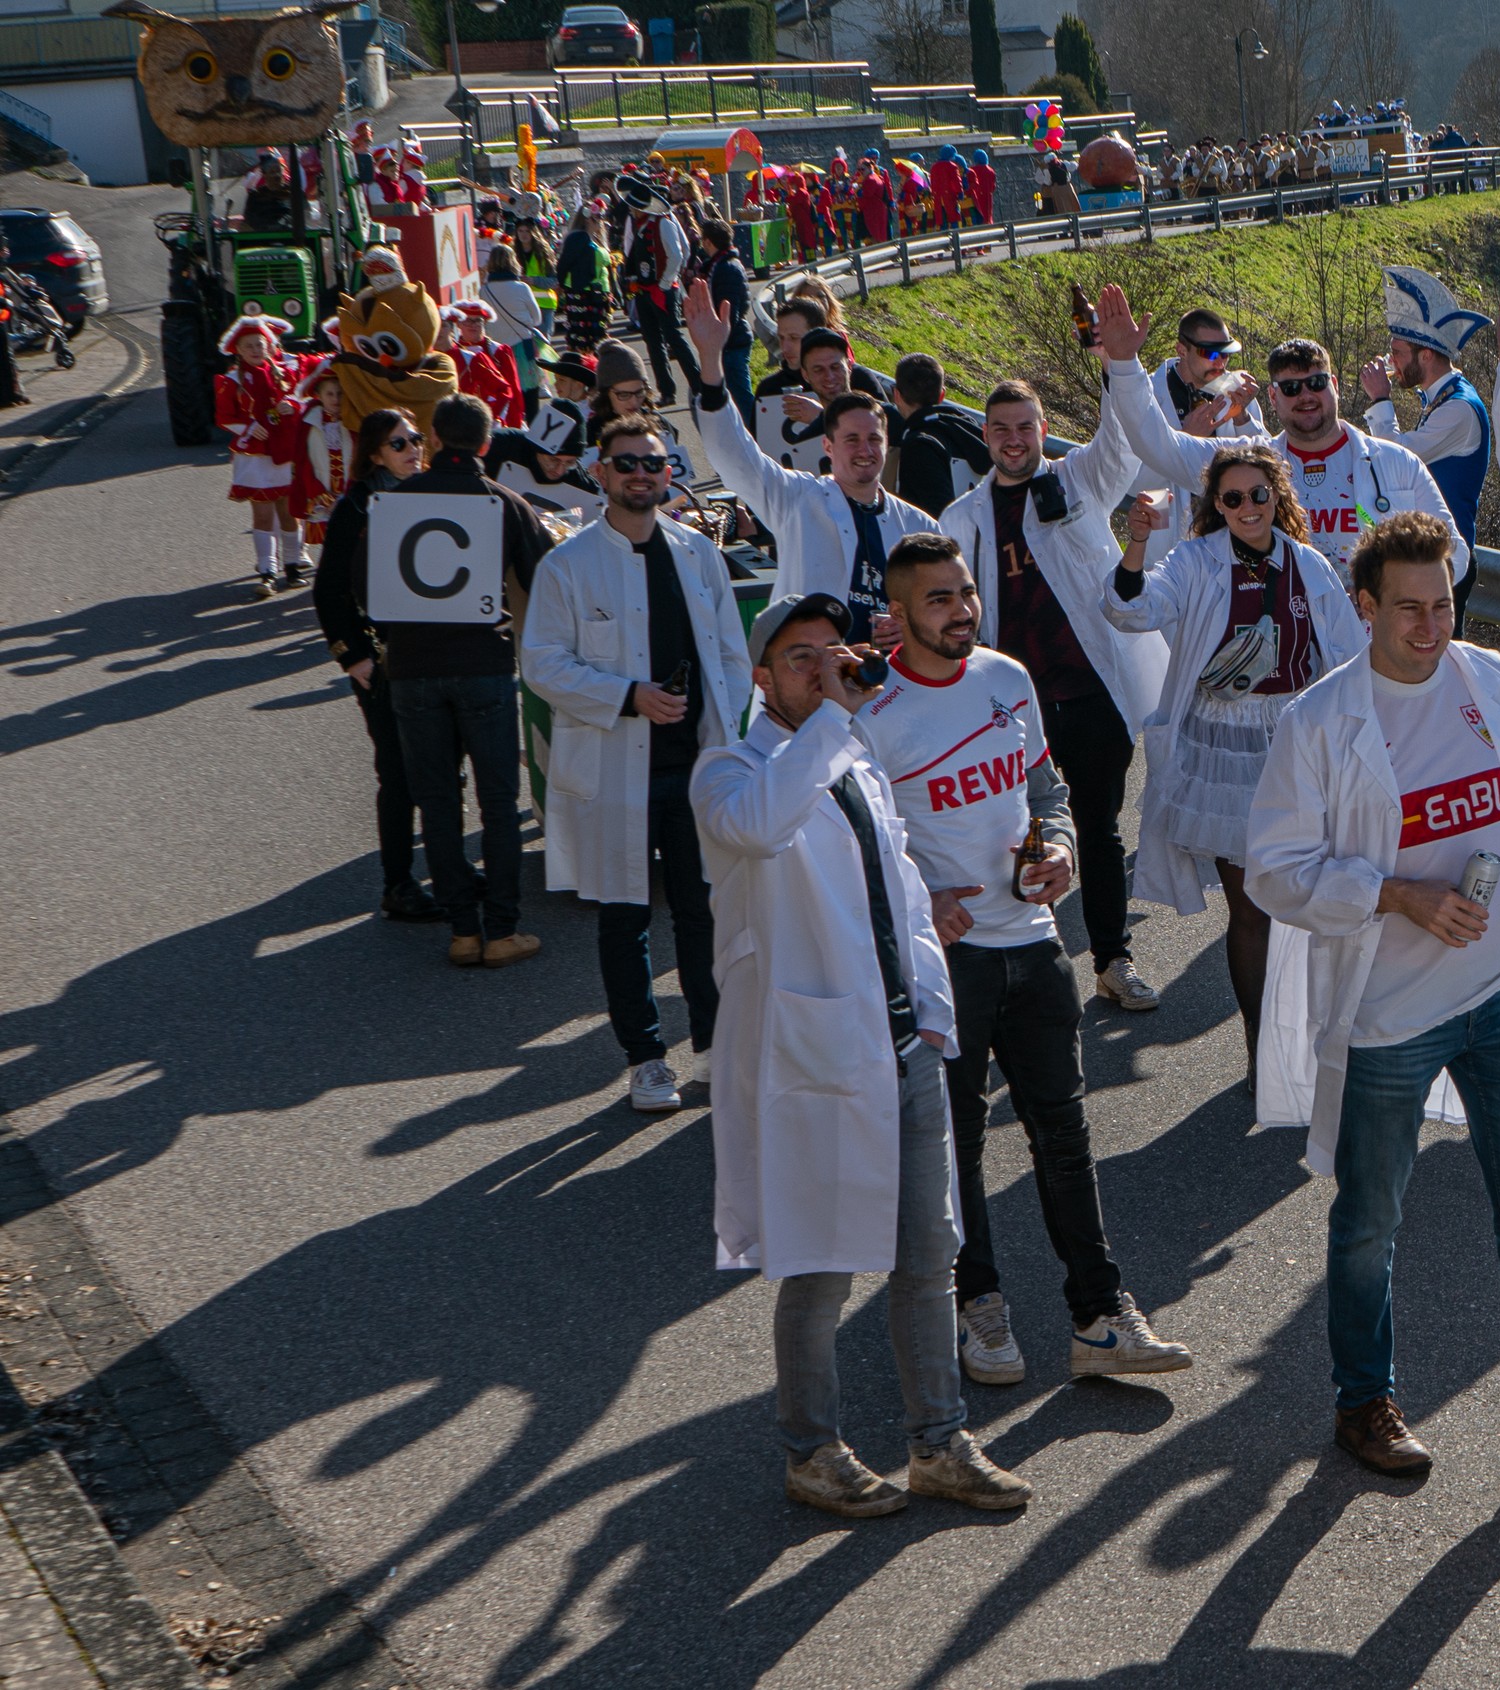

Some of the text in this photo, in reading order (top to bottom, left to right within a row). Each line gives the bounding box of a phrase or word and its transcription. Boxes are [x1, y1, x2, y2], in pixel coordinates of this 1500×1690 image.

[540, 413, 564, 441] Y
[1309, 508, 1359, 533] WE
[398, 517, 471, 600] C
[480, 595, 494, 615] 3
[870, 685, 905, 716] uhlsport
